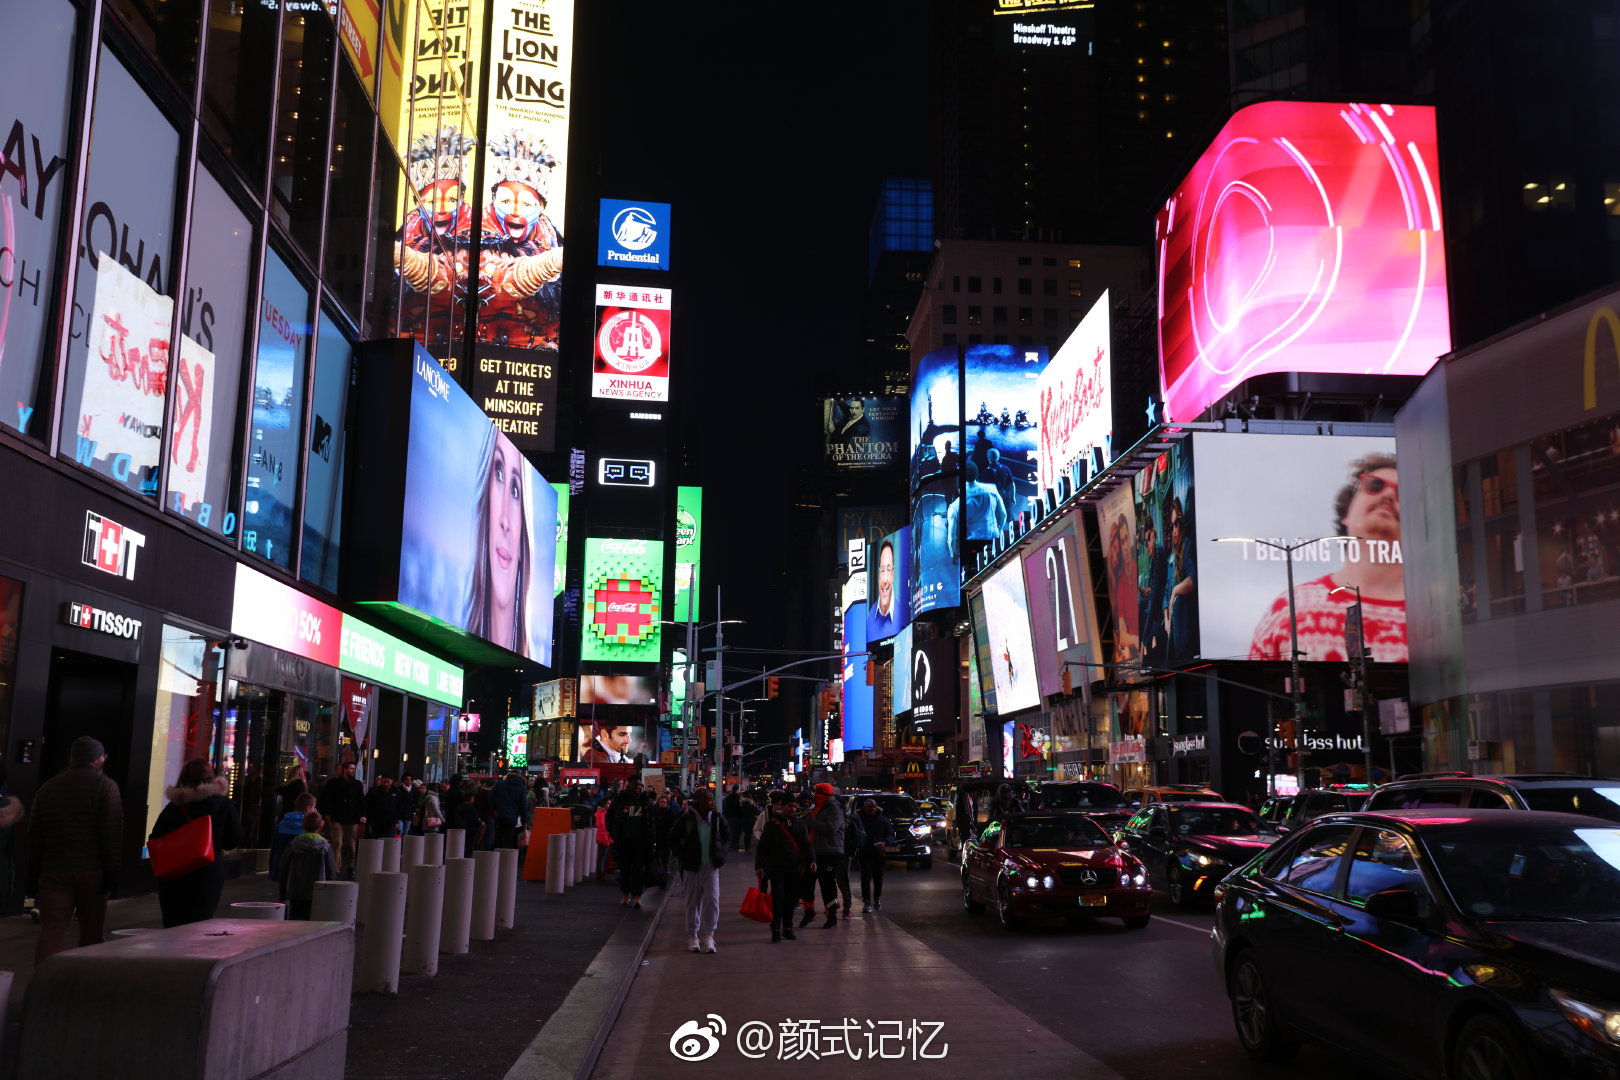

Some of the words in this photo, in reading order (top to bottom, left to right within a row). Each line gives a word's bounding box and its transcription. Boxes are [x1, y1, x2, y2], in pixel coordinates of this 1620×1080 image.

[511, 8, 551, 31] THE
[1013, 23, 1047, 34] Minskoff
[1047, 24, 1076, 35] Theatre
[503, 29, 559, 63] LION
[1013, 34, 1052, 47] Broadway
[1053, 36, 1060, 46] &
[496, 62, 565, 102] KING
[607, 250, 660, 264] Prudential
[603, 290, 664, 304] 新华通讯社
[480, 358, 502, 374] GET
[505, 360, 552, 379] TICKETS
[495, 379, 510, 394] AT
[512, 380, 534, 397] THE
[599, 388, 624, 397] NEWS
[626, 390, 662, 399] AGENCY
[609, 379, 653, 391] XINHUA
[484, 397, 544, 417] MINSKOFF
[629, 412, 662, 420] SAMSUNG
[826, 441, 899, 455] PHANTOM
[975, 533, 1006, 567] 1540
[1009, 433, 1114, 546] BROADWAY
[843, 511, 865, 527] MY
[1256, 537, 1331, 563] BELONG
[1338, 539, 1361, 563] TO
[1045, 535, 1079, 653] 21
[607, 601, 638, 613] Coca-Cola
[92, 607, 142, 640] TISSOT
[299, 610, 322, 646] 50%
[350, 630, 386, 670] FRIENDS
[395, 650, 412, 679] NEW
[412, 657, 430, 687] YORK
[1336, 733, 1363, 750] hut
